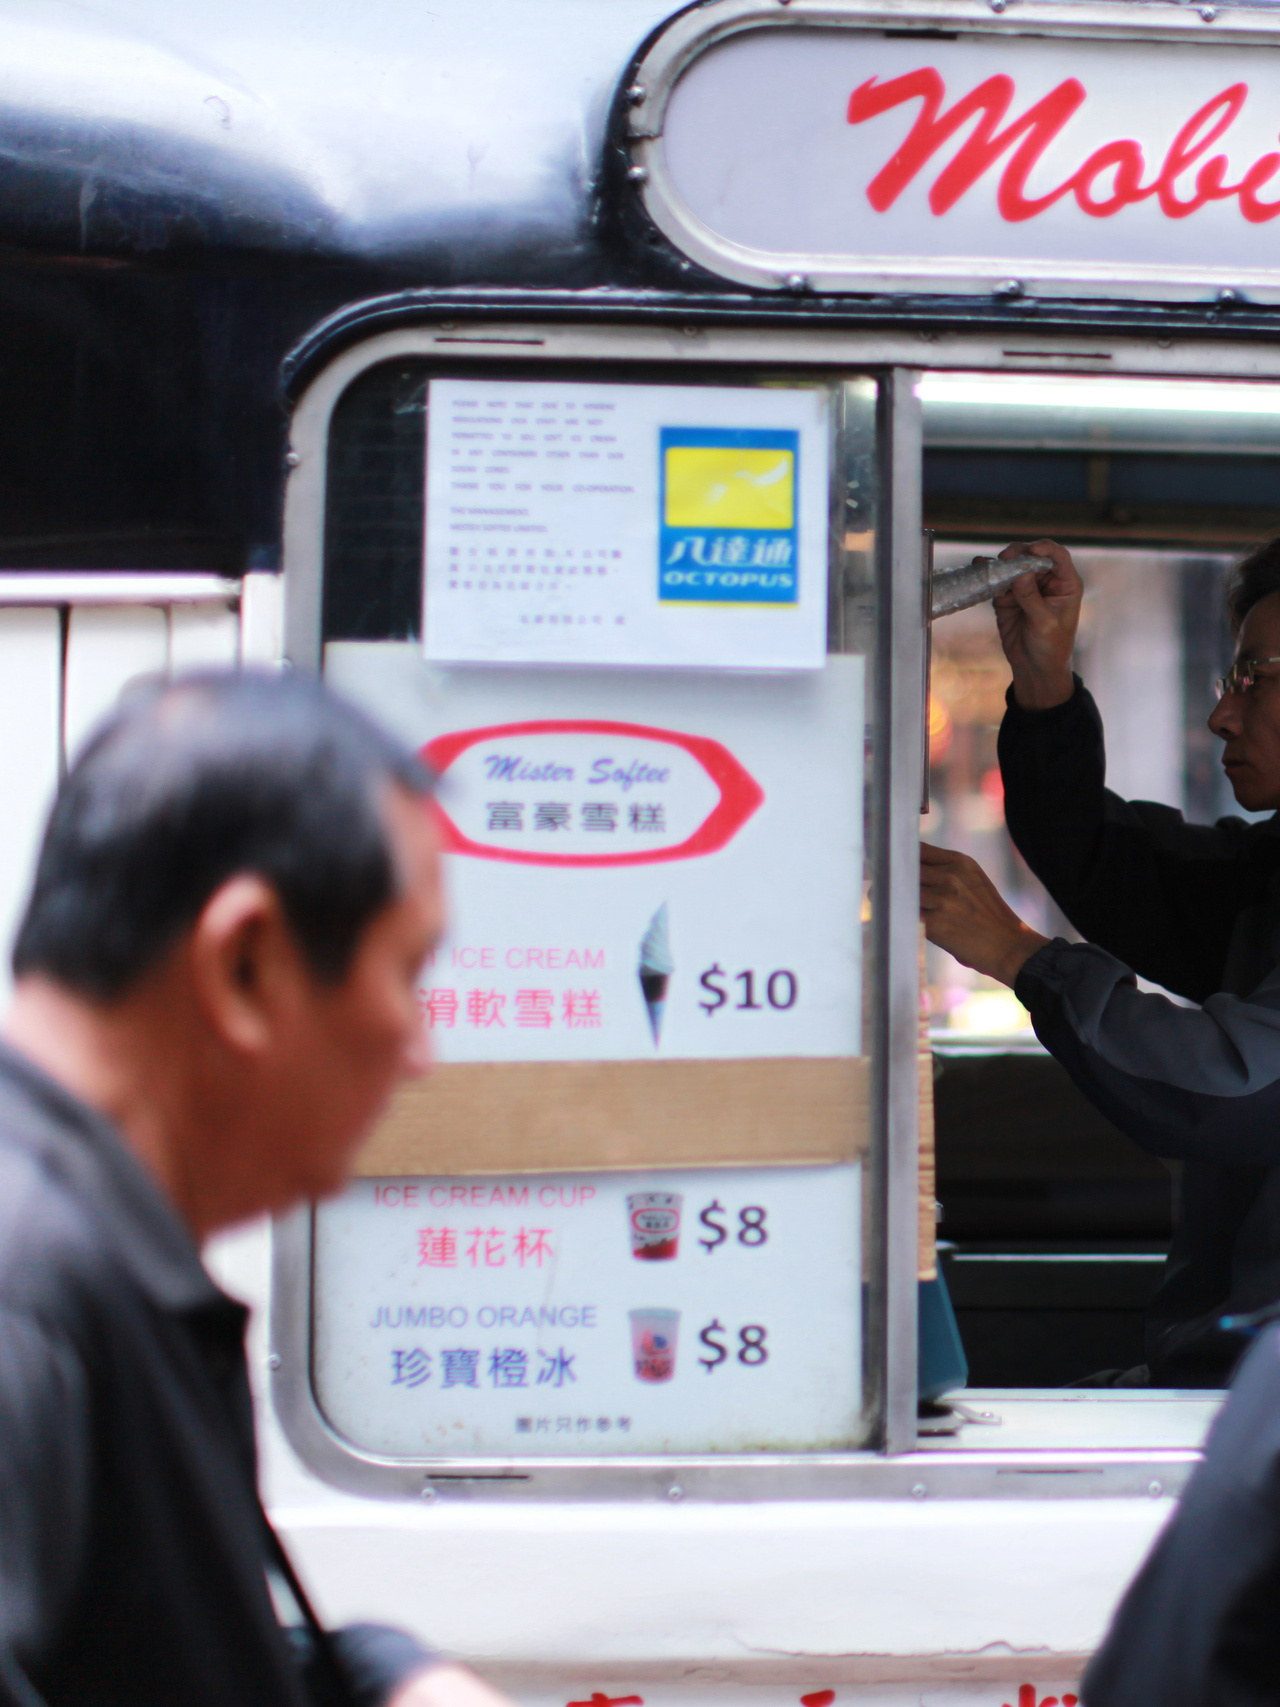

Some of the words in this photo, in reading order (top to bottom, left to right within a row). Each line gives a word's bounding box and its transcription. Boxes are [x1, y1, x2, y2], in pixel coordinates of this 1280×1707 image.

[666, 536, 792, 567] 八達通
[664, 571, 793, 587] OCTOPUS
[485, 755, 574, 782] Mister
[588, 758, 670, 792] Softee
[487, 801, 665, 832] 富豪雪糕
[452, 948, 496, 968] ICE
[506, 948, 604, 969] CREAM
[699, 963, 797, 1016] $10
[419, 988, 601, 1029] 滑軟雪糕
[374, 1186, 418, 1207] ICE
[428, 1185, 530, 1208] CREAM
[538, 1185, 597, 1207] CUP
[699, 1200, 768, 1253] $8
[417, 1227, 553, 1267] 蓮花杯
[370, 1306, 468, 1328] JUMBO
[477, 1306, 597, 1328] ORANGE
[699, 1319, 768, 1372] $8
[392, 1347, 576, 1388] 珍寶橙冰
